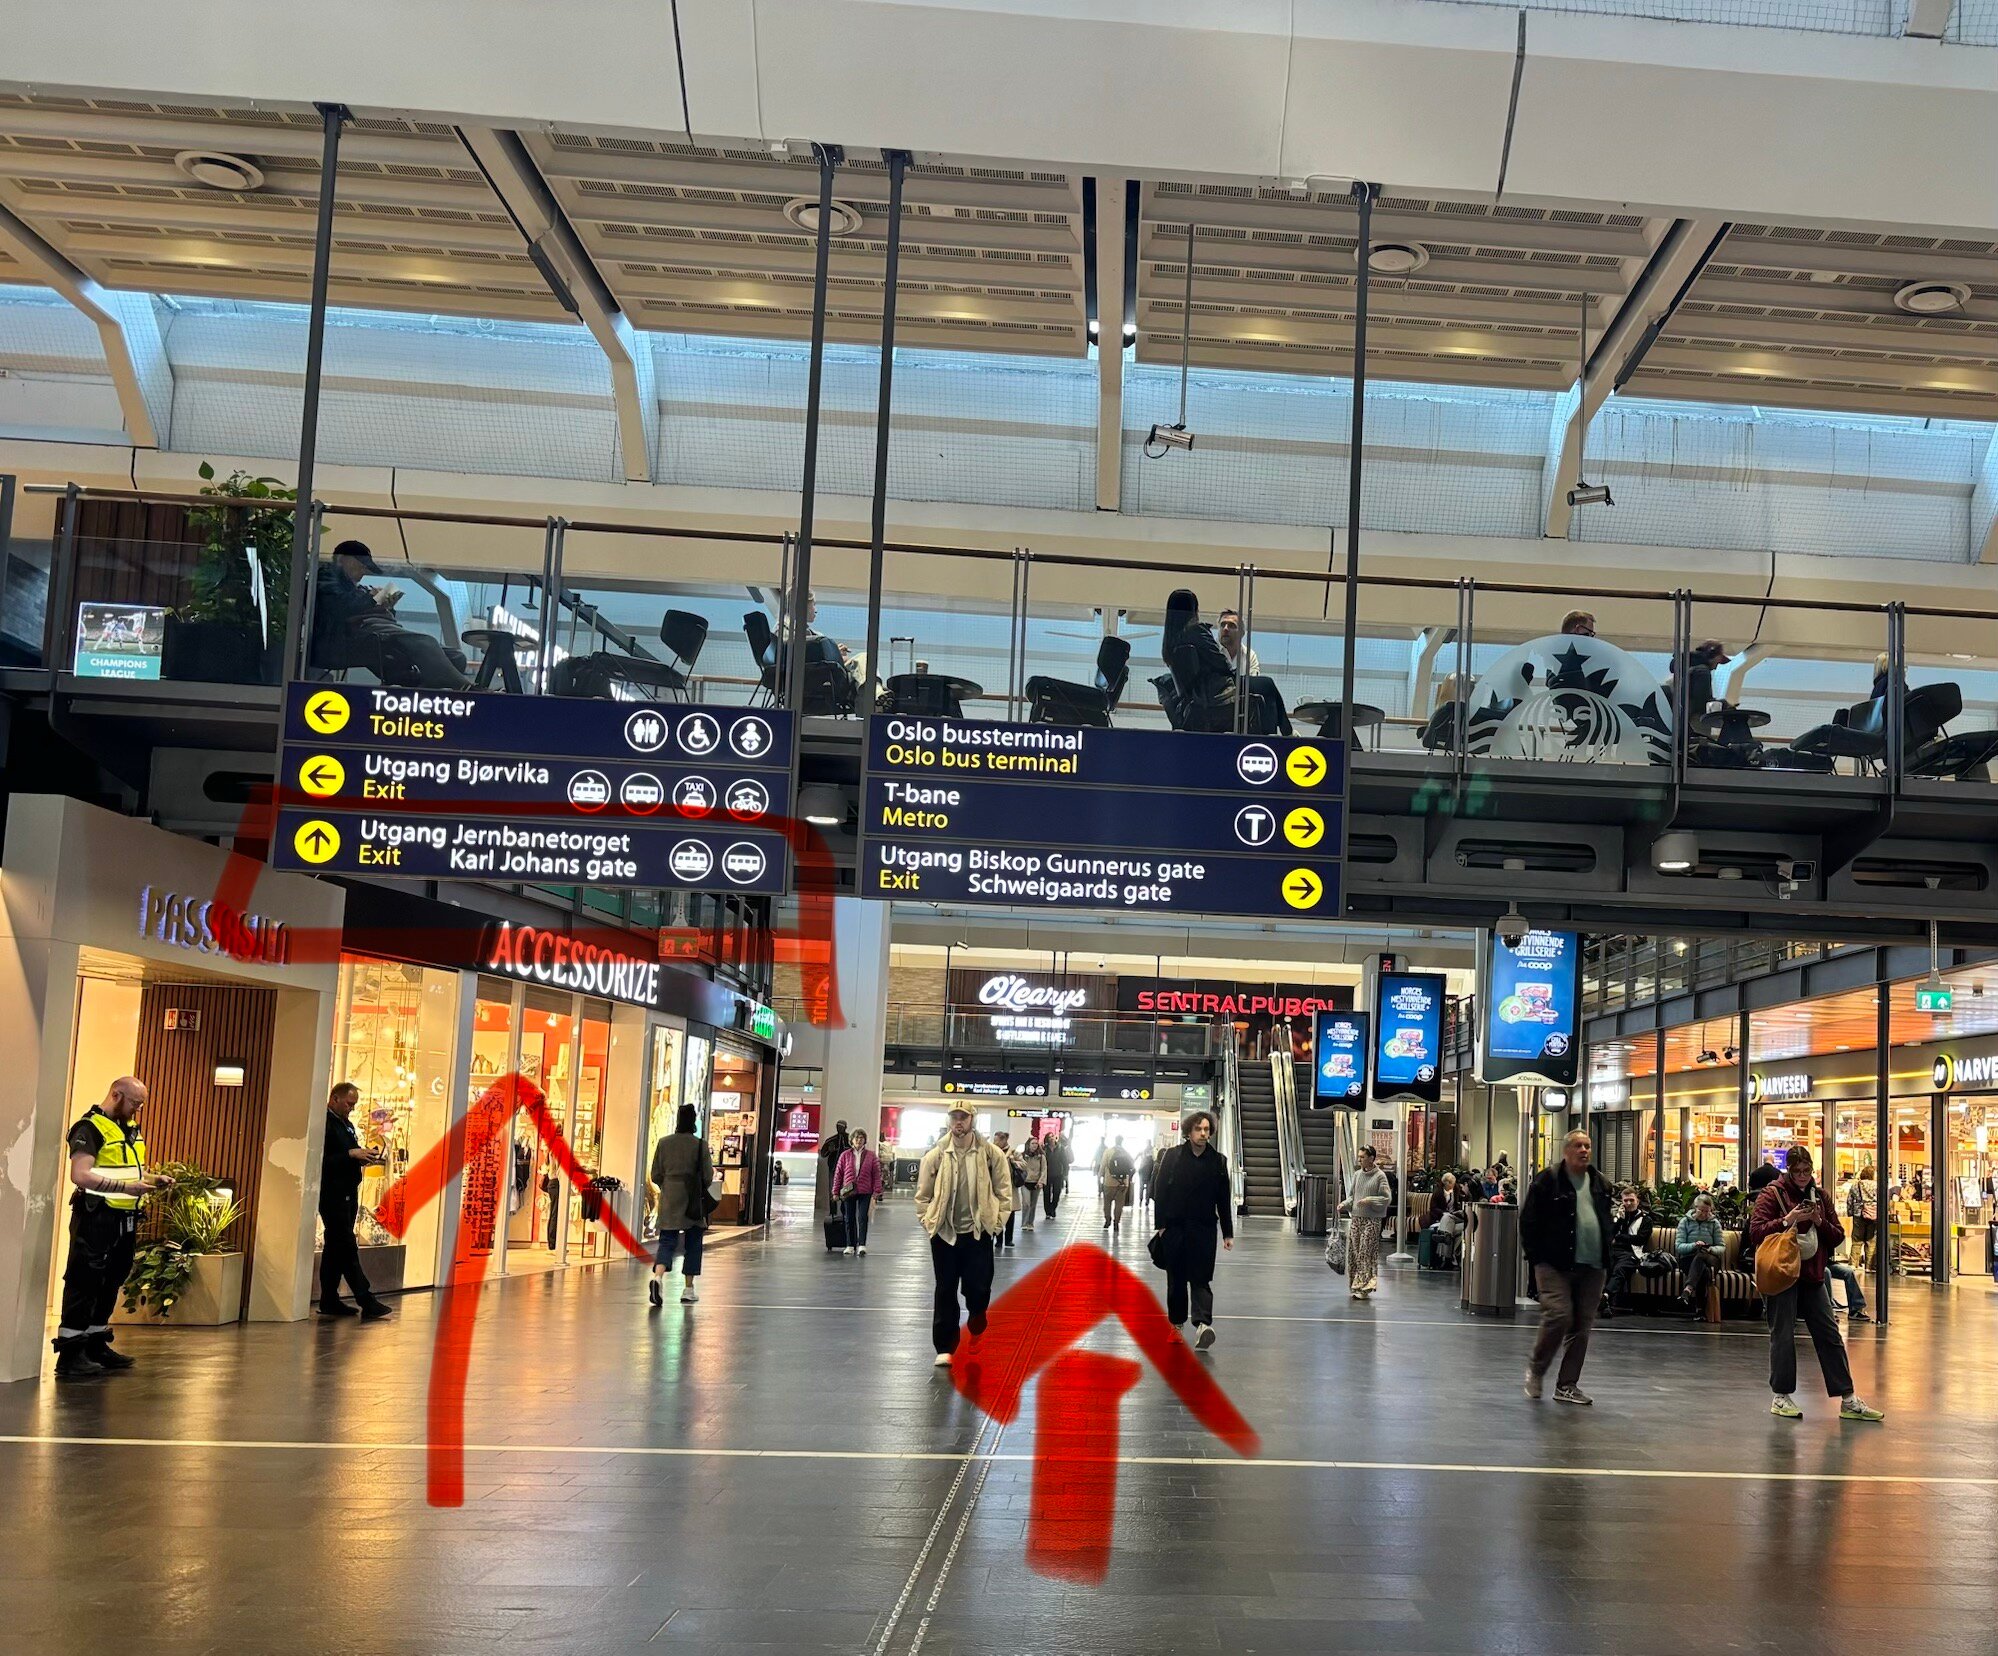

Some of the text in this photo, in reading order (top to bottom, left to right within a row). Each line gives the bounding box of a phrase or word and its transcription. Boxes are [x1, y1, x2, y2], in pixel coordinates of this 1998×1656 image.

[90, 658, 147, 669] CHAMPIONS
[101, 669, 135, 678] LEAGUE
[371, 690, 475, 717] Toaletter
[370, 715, 445, 739] Toilets
[886, 720, 1083, 750] Oslo bussterminal
[364, 754, 549, 785] Utgang Bjørvika
[886, 744, 1078, 774] Oslo bus terminal
[363, 779, 406, 800] Exit
[684, 782, 704, 792] TAXI
[883, 782, 961, 806] T-bane
[882, 806, 949, 829] Metro
[360, 819, 630, 856] Utgang Jernbanetorget
[358, 844, 637, 880] Exit Karl Johans gate
[880, 845, 1205, 883] Utgang Biskop Gunnerus gate
[879, 869, 1172, 905] Exit Schweigaards gate
[490, 920, 660, 1005] ACCESSORIZE
[1515, 946, 1556, 957] GRILLSERIE
[979, 975, 1086, 1016] O'Learys
[1138, 991, 1334, 1016] SENTRALPUBEN
[1760, 1075, 1808, 1095] NARVESEN
